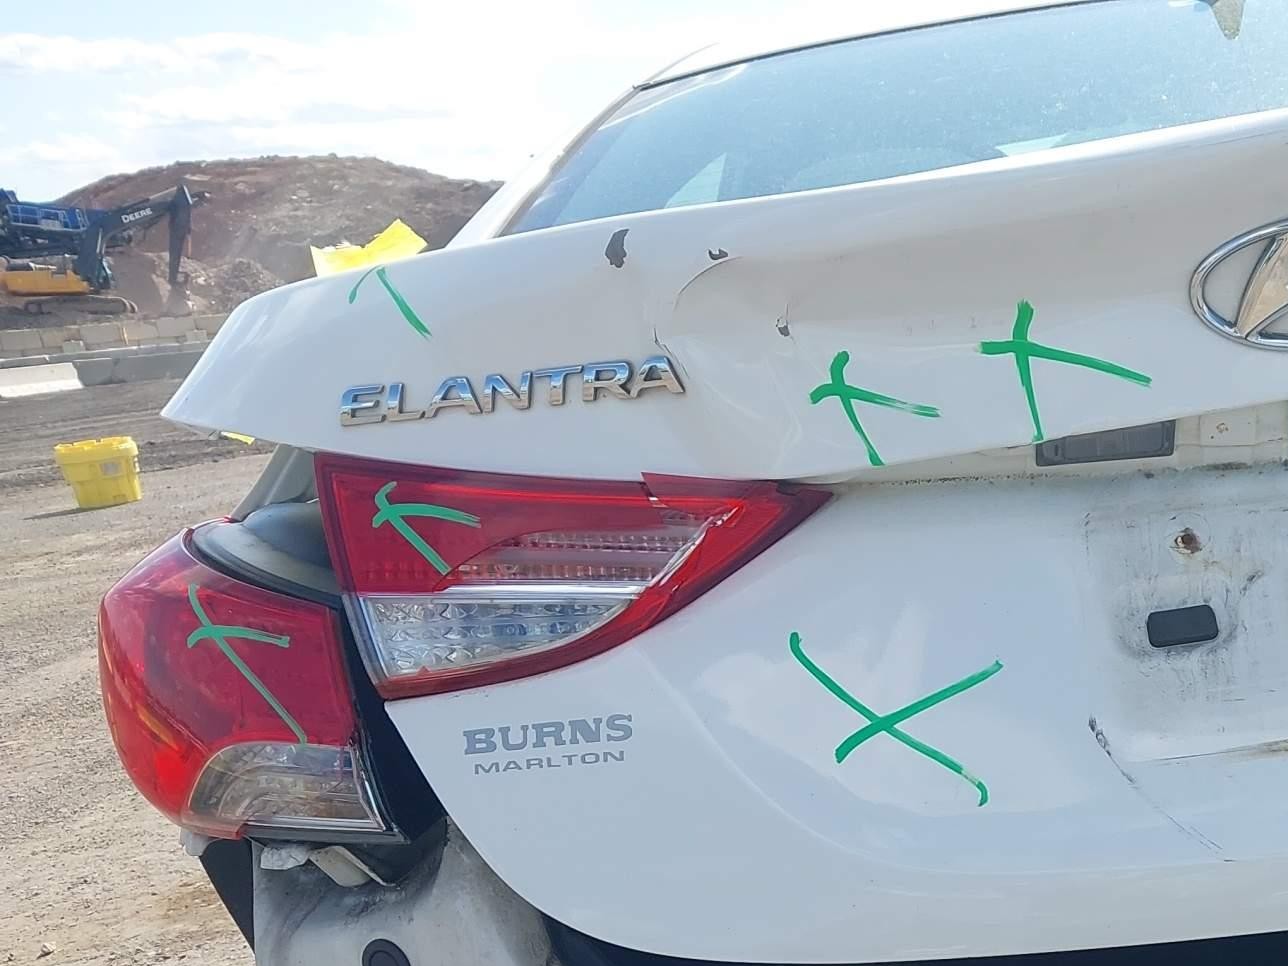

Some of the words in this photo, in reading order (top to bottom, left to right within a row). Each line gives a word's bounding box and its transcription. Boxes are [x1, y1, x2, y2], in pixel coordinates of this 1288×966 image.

[121, 207, 153, 223] DEERE
[340, 355, 686, 427] ELANTRA
[463, 714, 633, 755] BURNS
[474, 750, 625, 775] MARLTON
